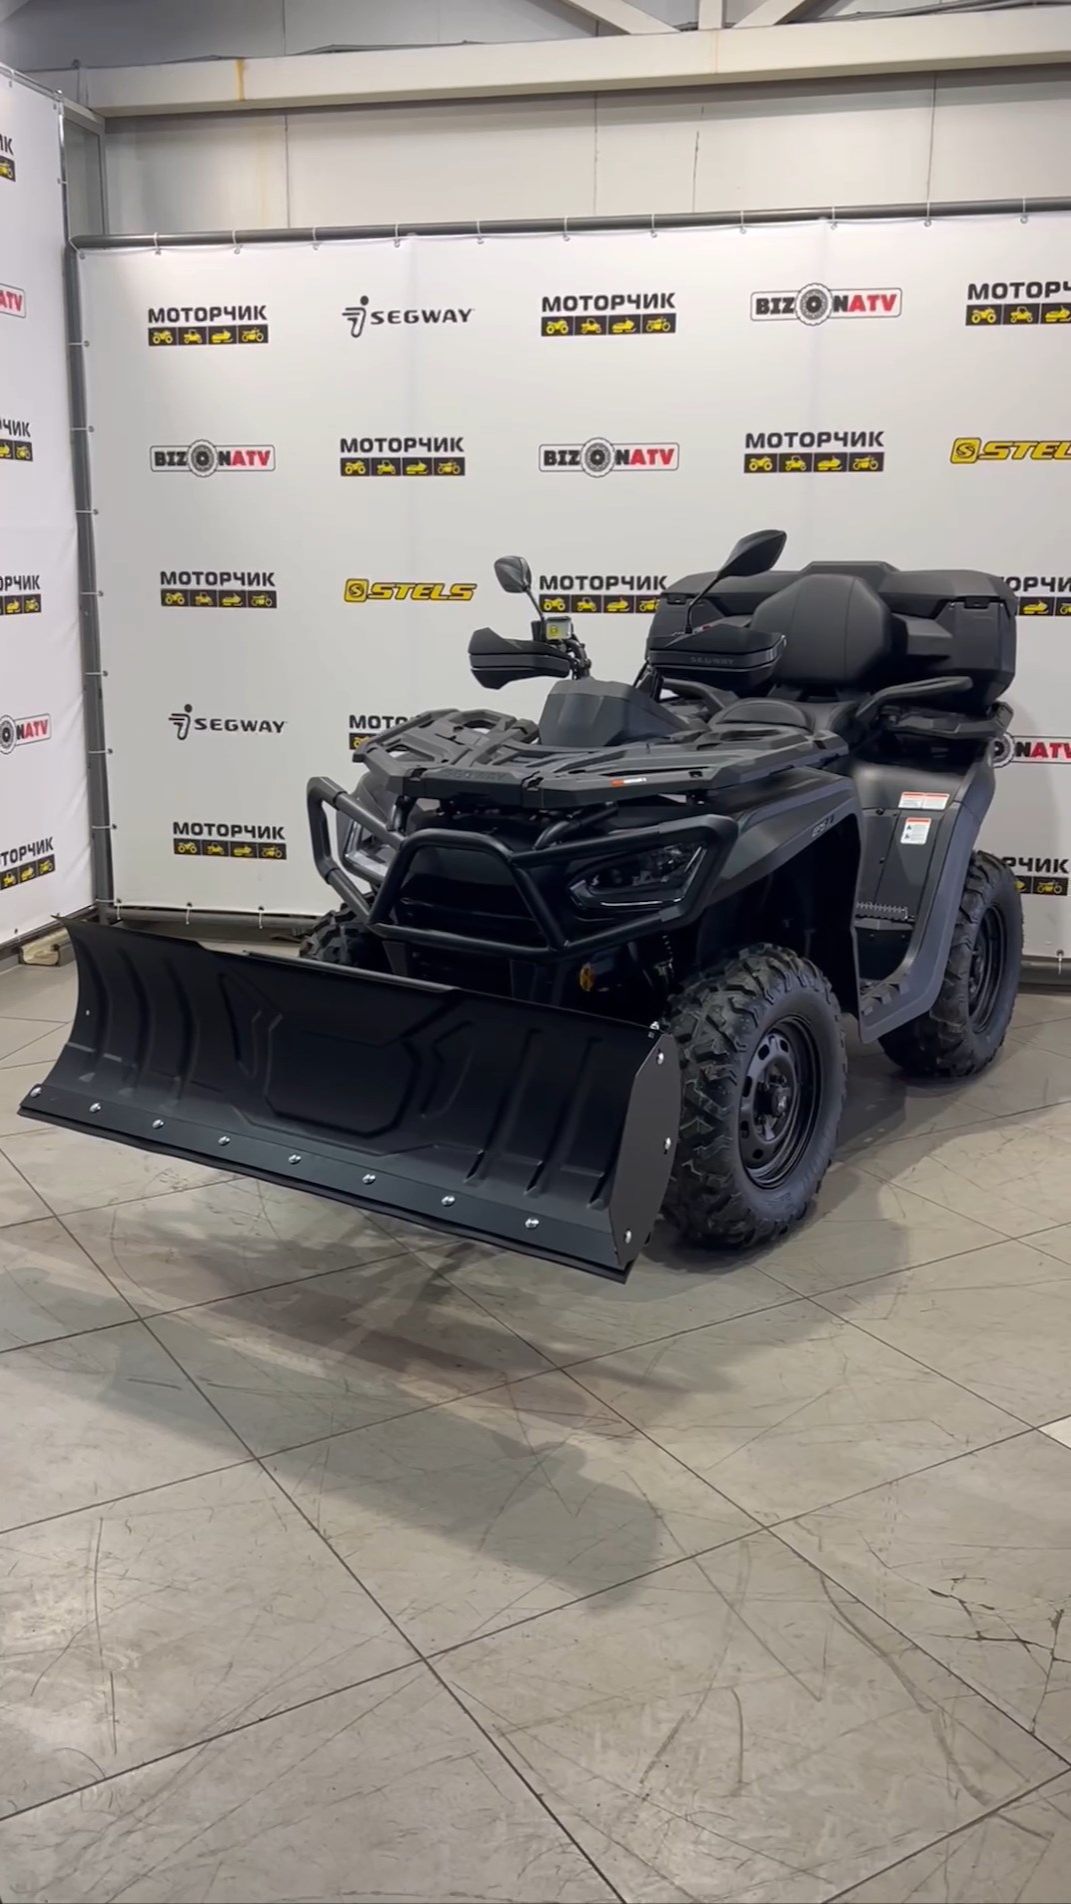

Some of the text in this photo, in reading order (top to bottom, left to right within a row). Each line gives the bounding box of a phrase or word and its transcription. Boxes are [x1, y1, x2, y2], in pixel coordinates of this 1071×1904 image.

[541, 293, 676, 315] МОТОРЧИК
[147, 304, 268, 324] МОТОРЧИК
[370, 307, 471, 326] SEGWAY
[339, 437, 465, 455] МОТОРЧИК
[745, 431, 885, 451] МОТОРЧИК
[977, 440, 1071, 461] STEL
[159, 570, 276, 587] МОТОРЧИК
[539, 574, 667, 592] МОТОРЧИК
[366, 582, 478, 601] STELS
[193, 717, 286, 734] SEGWAY
[172, 821, 287, 840] МОТОРЧИК
[0, 836, 54, 866] ТОРЧИК
[1002, 856, 1069, 874] РЧИК
